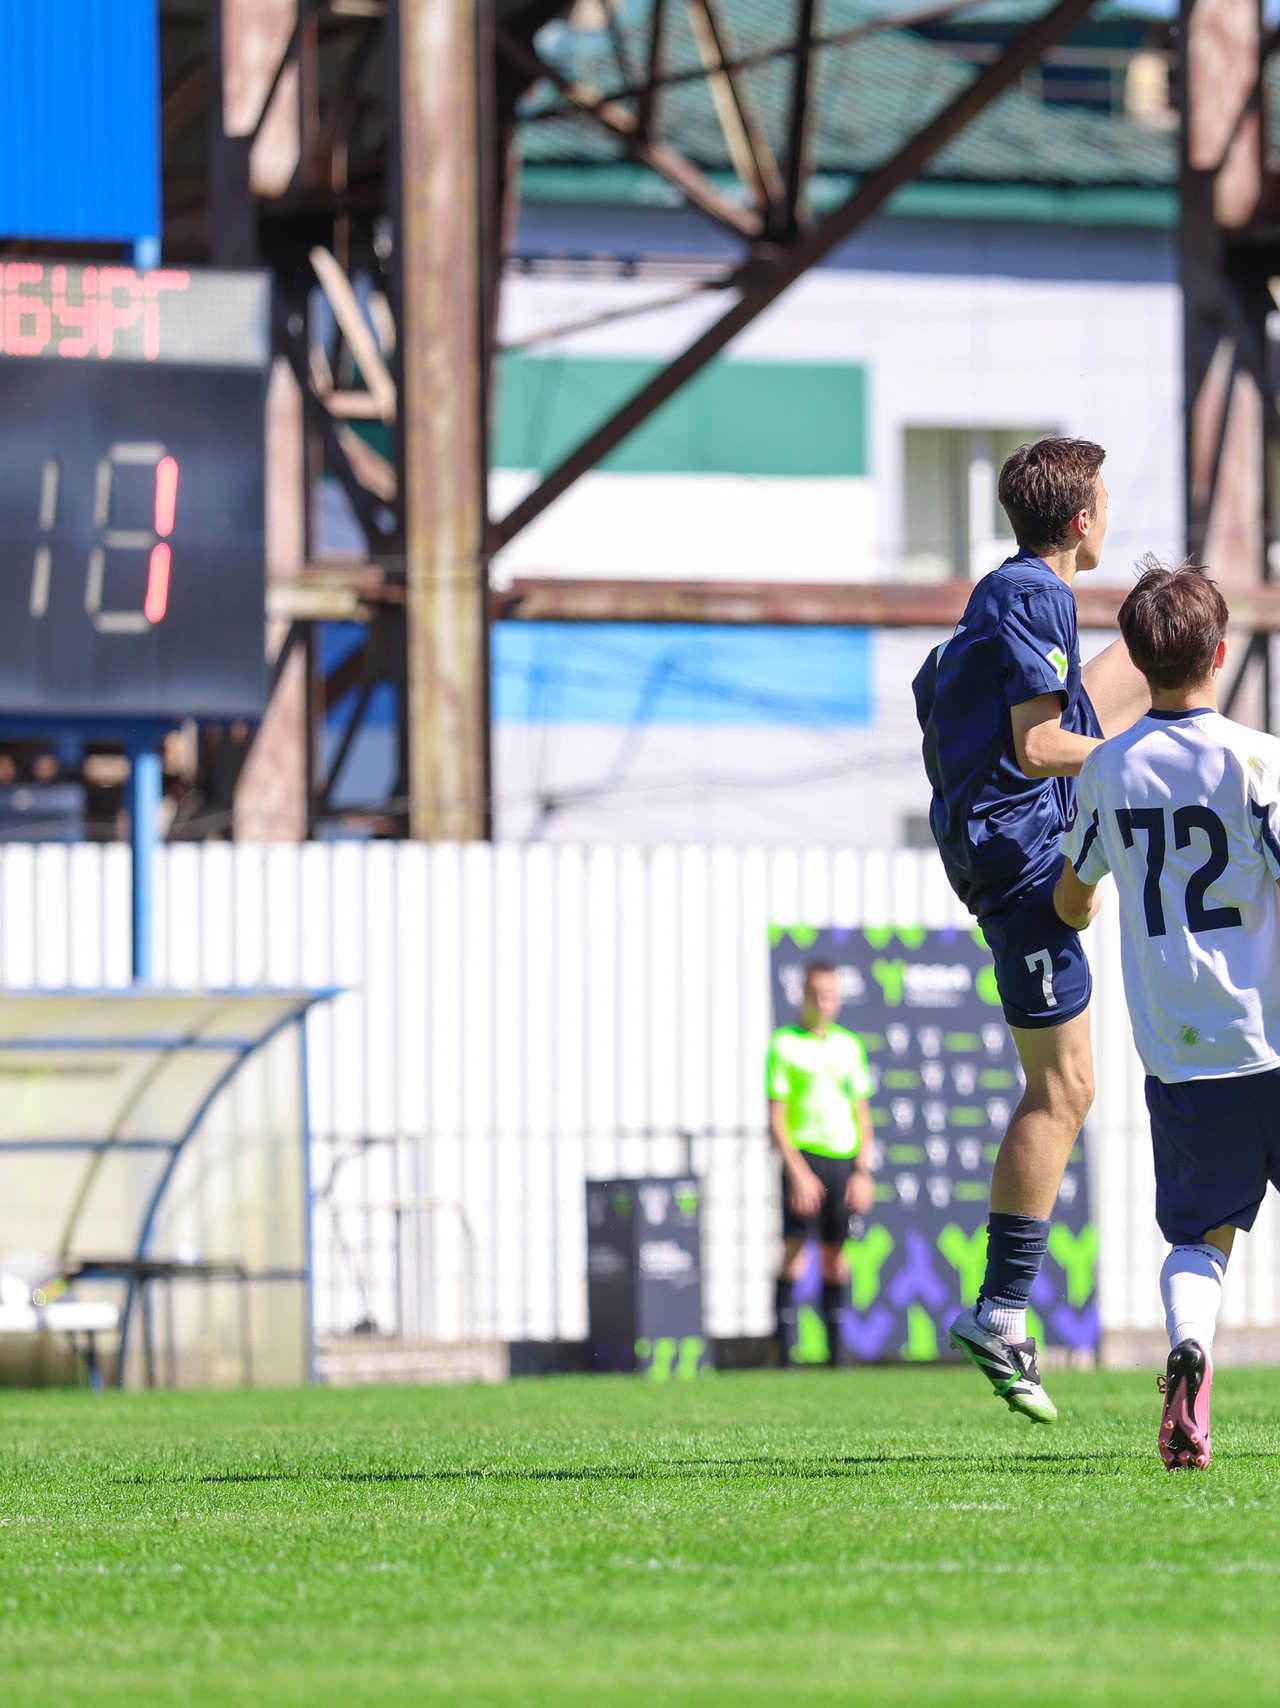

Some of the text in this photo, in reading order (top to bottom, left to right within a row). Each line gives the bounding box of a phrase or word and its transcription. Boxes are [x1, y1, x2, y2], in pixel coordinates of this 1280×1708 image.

[0, 262, 190, 361] БУРГ
[1114, 804, 1243, 938] 72
[1024, 948, 1058, 1008] 7
